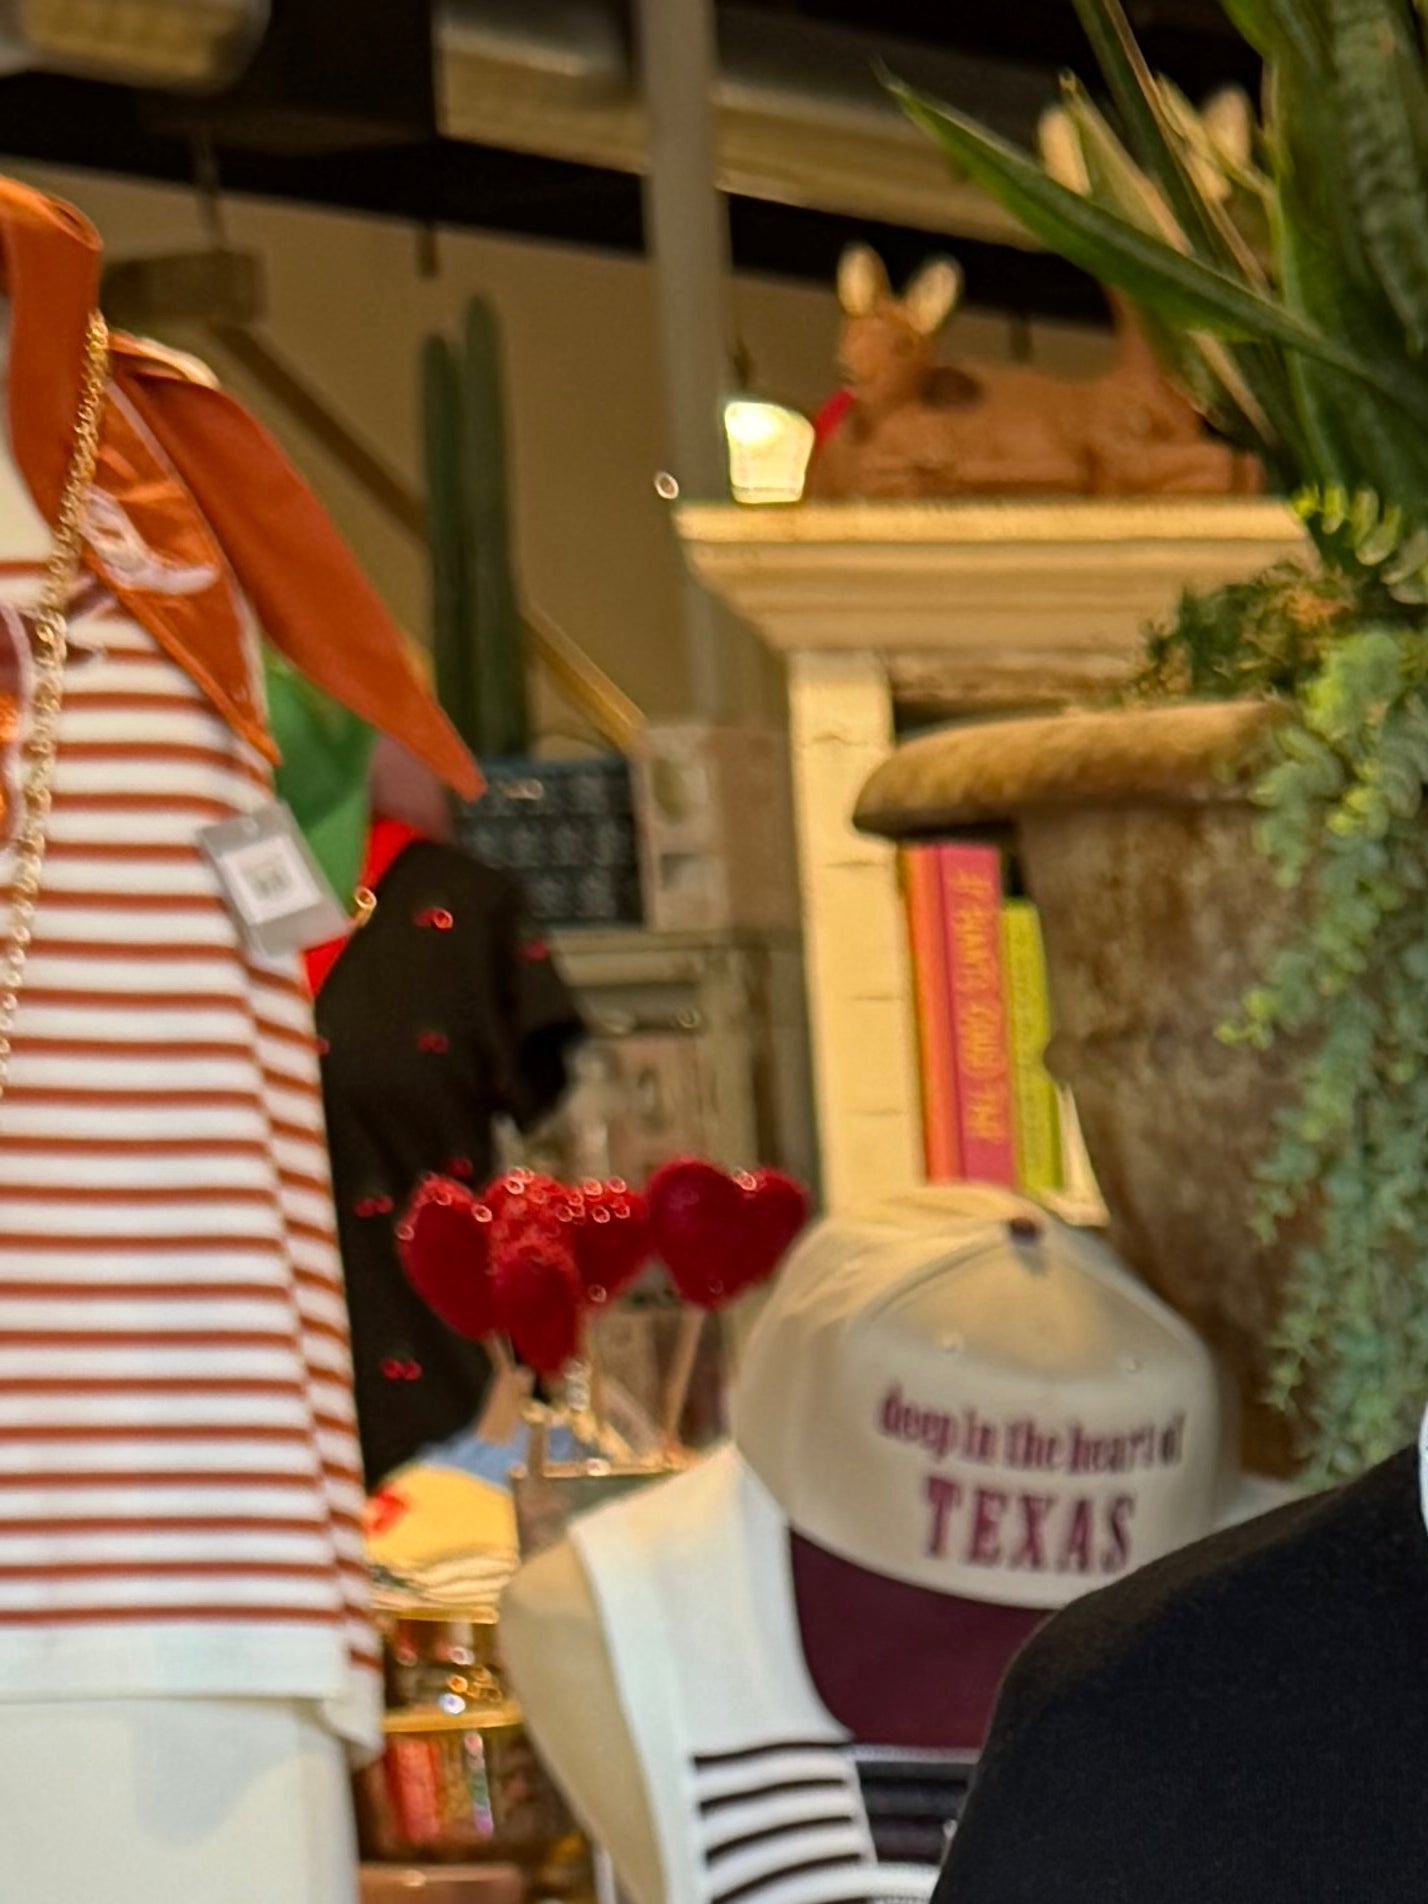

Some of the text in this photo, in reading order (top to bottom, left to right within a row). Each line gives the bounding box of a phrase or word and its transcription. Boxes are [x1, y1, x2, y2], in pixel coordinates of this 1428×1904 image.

[876, 1378, 958, 1460] deep
[962, 1404, 997, 1463] in
[1002, 1417, 1060, 1472] the
[1066, 1419, 1156, 1476] heart
[924, 1473, 1138, 1575] TEXAS
